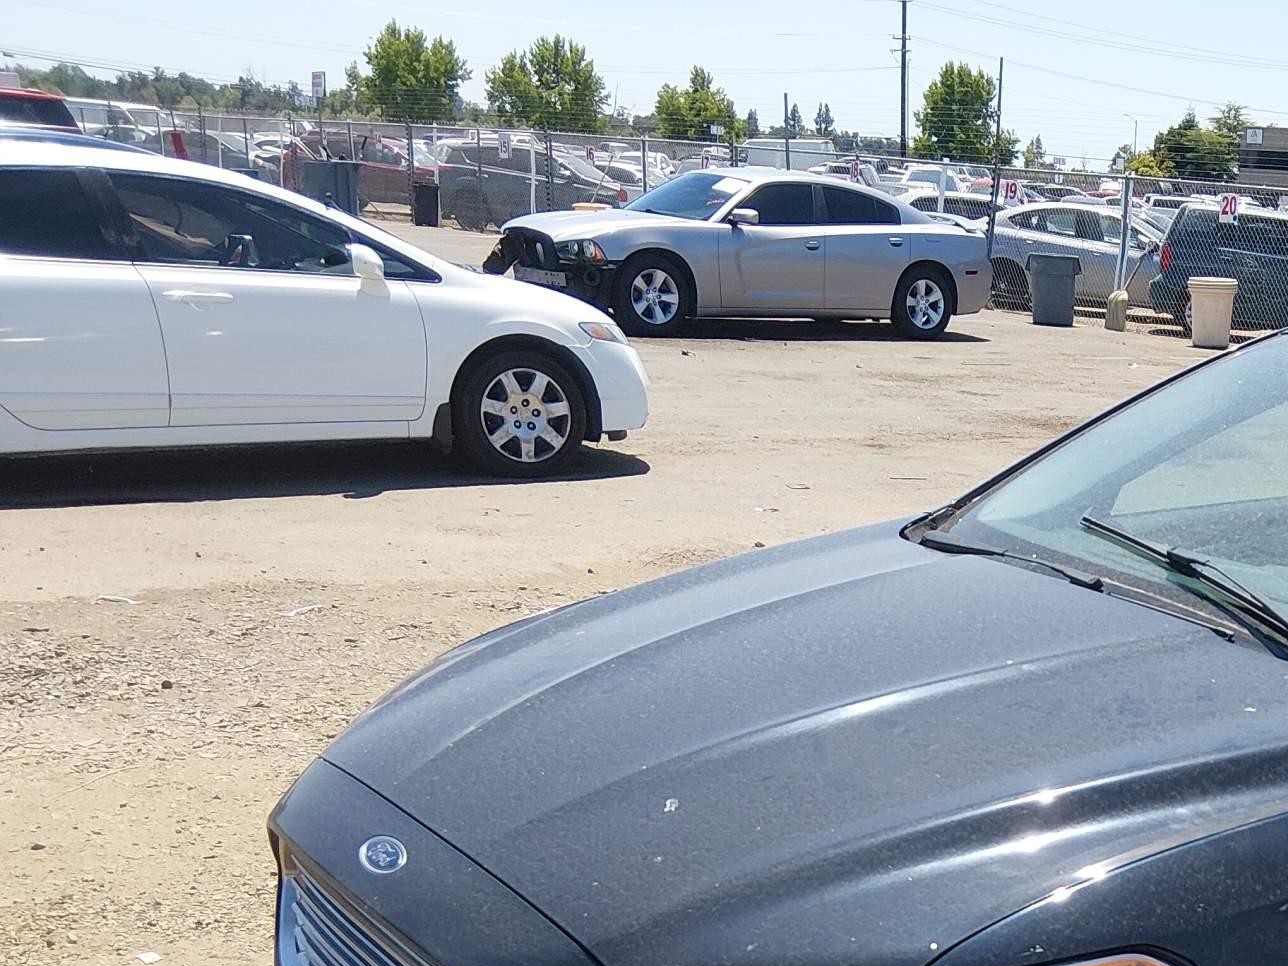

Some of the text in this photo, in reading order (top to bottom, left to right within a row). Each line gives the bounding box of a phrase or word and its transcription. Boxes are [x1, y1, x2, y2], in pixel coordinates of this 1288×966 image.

[586, 146, 595, 161] 16
[1005, 182, 1018, 200] 19
[1221, 196, 1237, 215] 20
